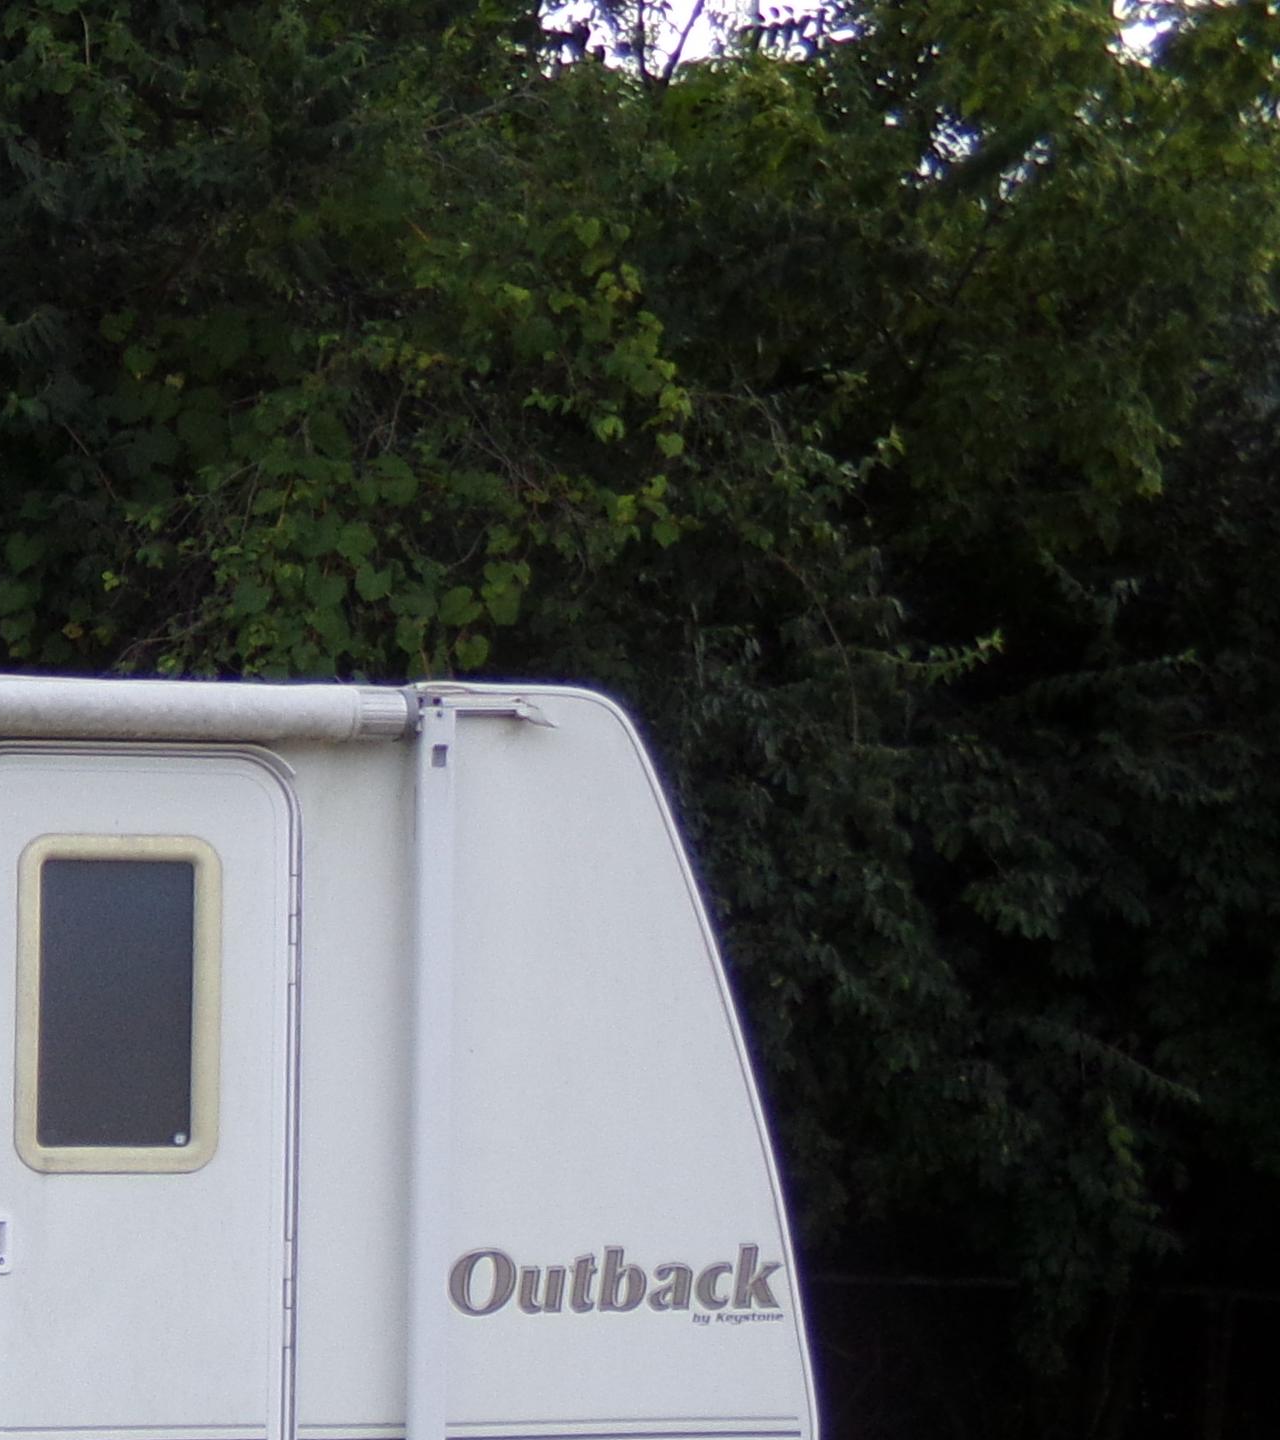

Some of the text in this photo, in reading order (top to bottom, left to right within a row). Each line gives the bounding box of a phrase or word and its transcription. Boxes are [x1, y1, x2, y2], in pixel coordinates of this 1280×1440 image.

[448, 1243, 784, 1317] Outback
[692, 1312, 784, 1325] by Keystone
